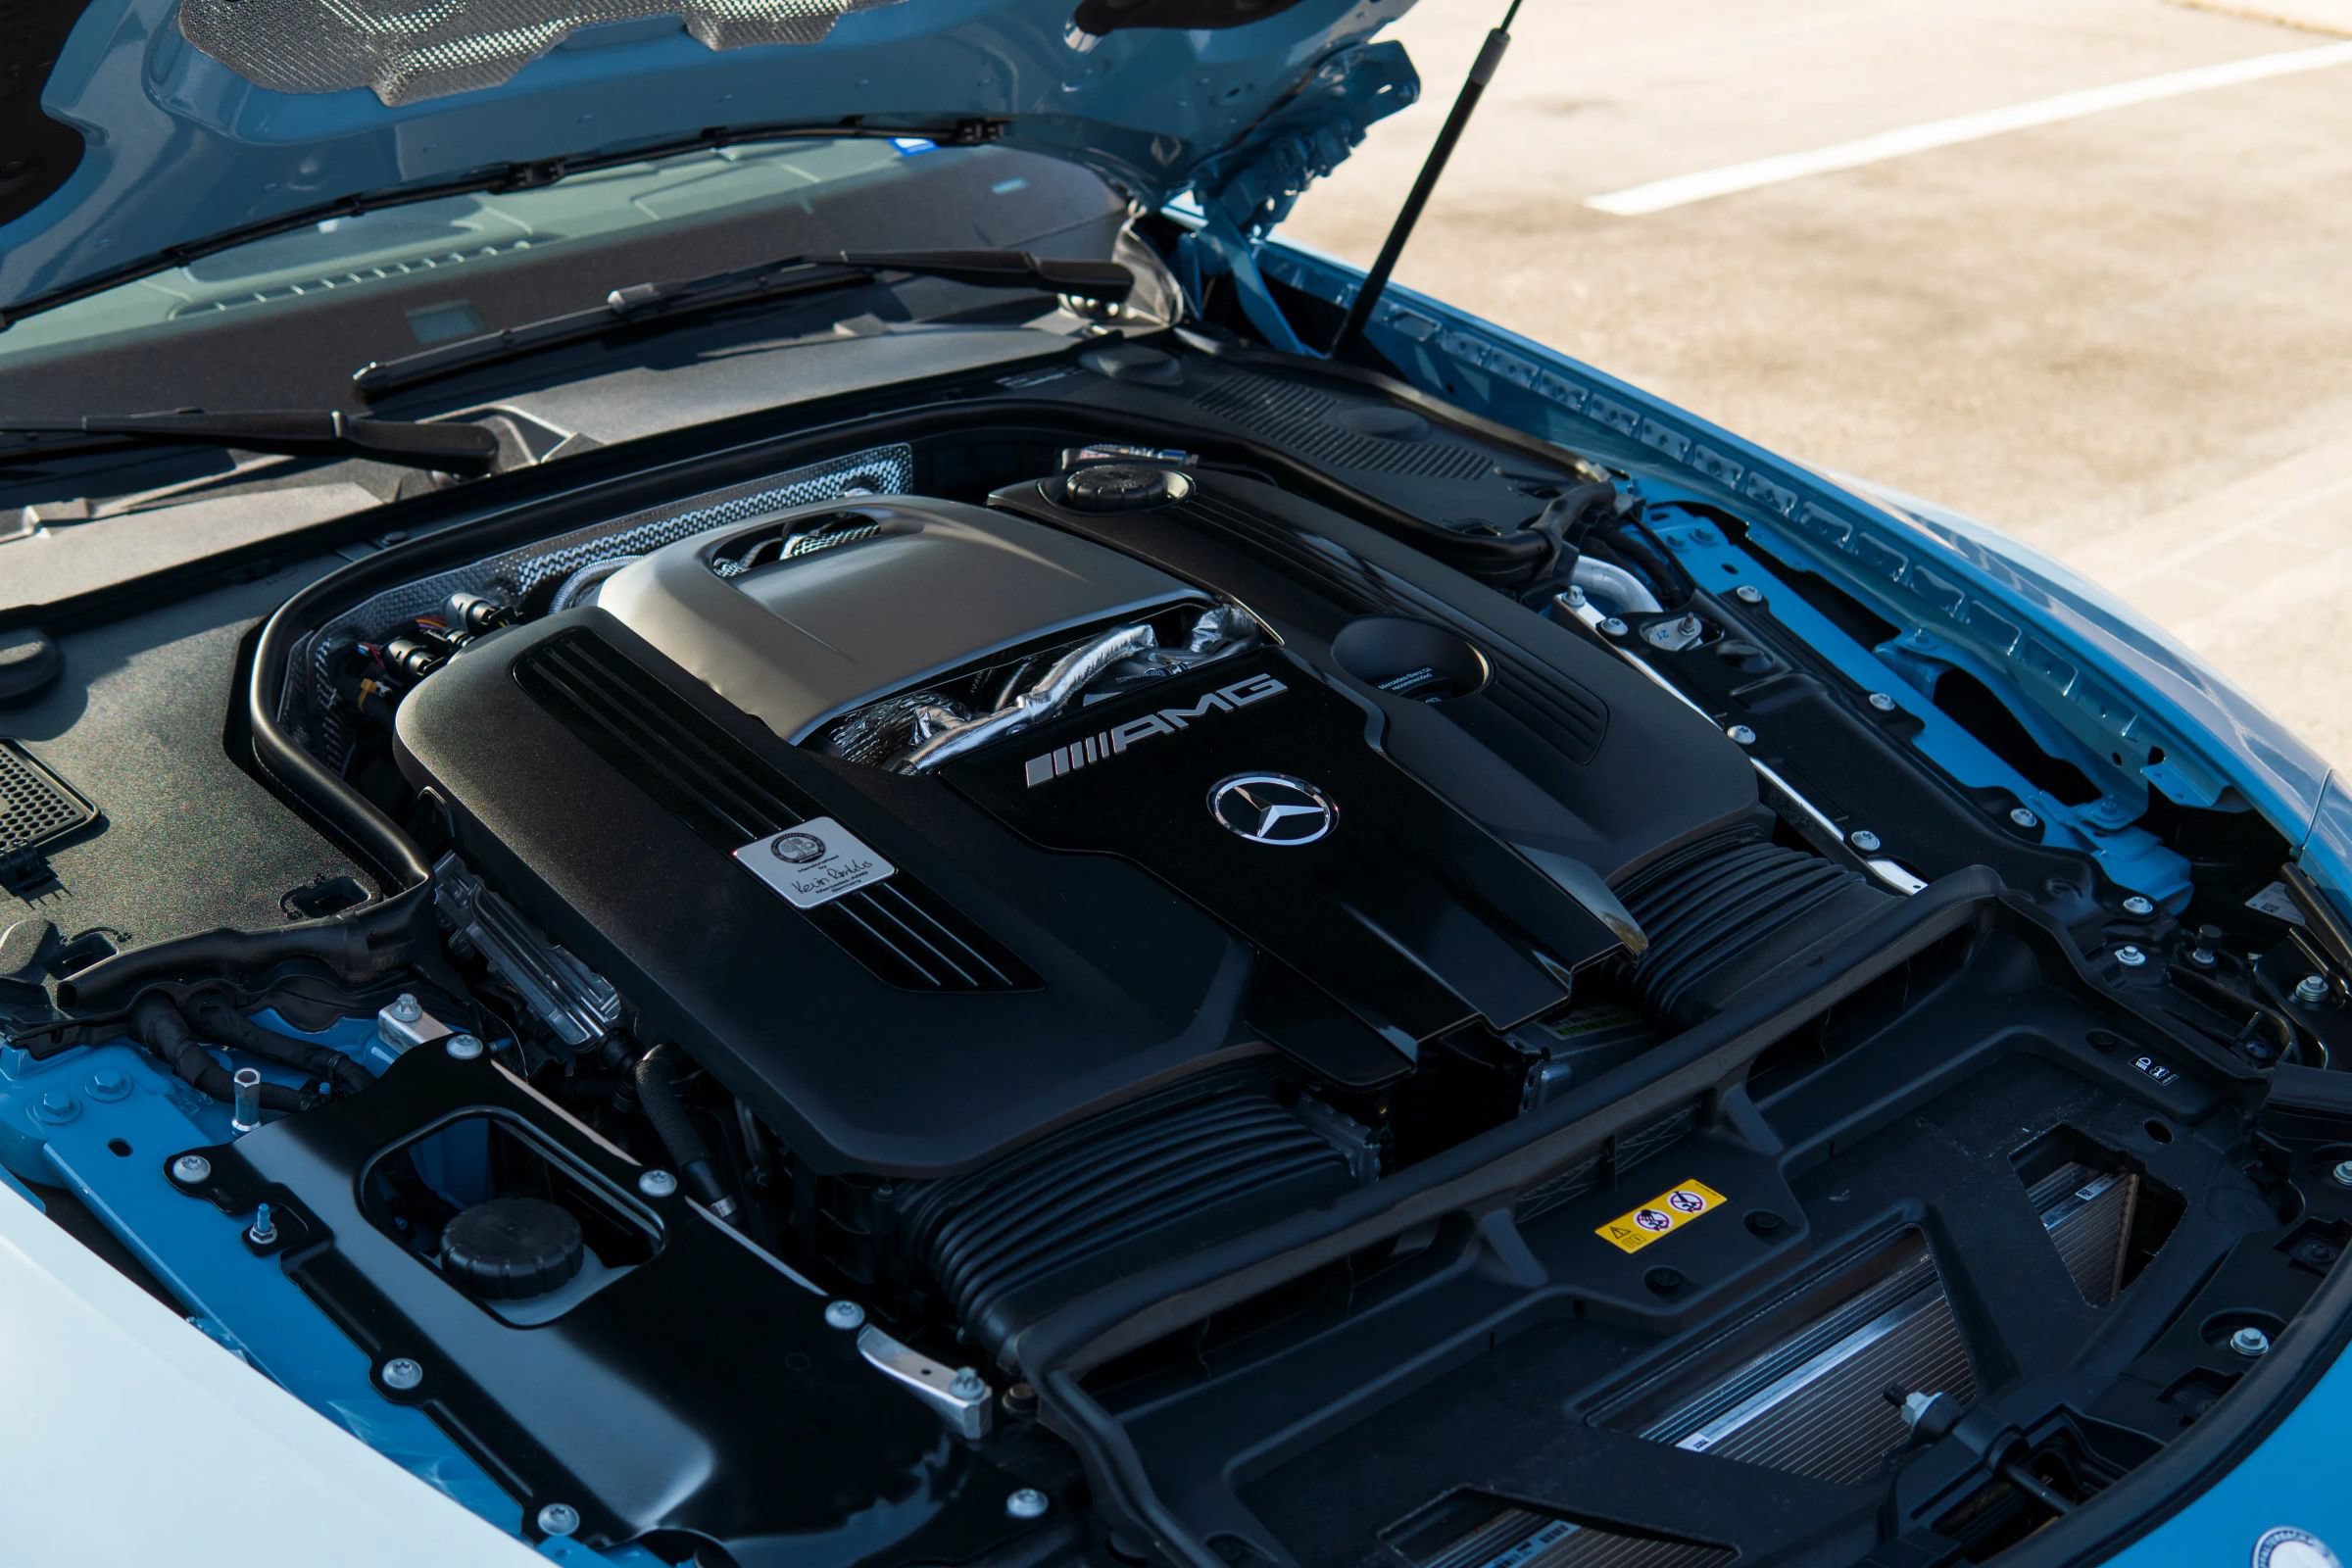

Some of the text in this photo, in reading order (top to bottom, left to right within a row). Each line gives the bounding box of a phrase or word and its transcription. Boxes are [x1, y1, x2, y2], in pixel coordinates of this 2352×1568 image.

[1391, 672, 1435, 691] recommended
[1110, 672, 1289, 755] AMG
[791, 877, 829, 895] Kevin
[830, 879, 862, 894] Germany
